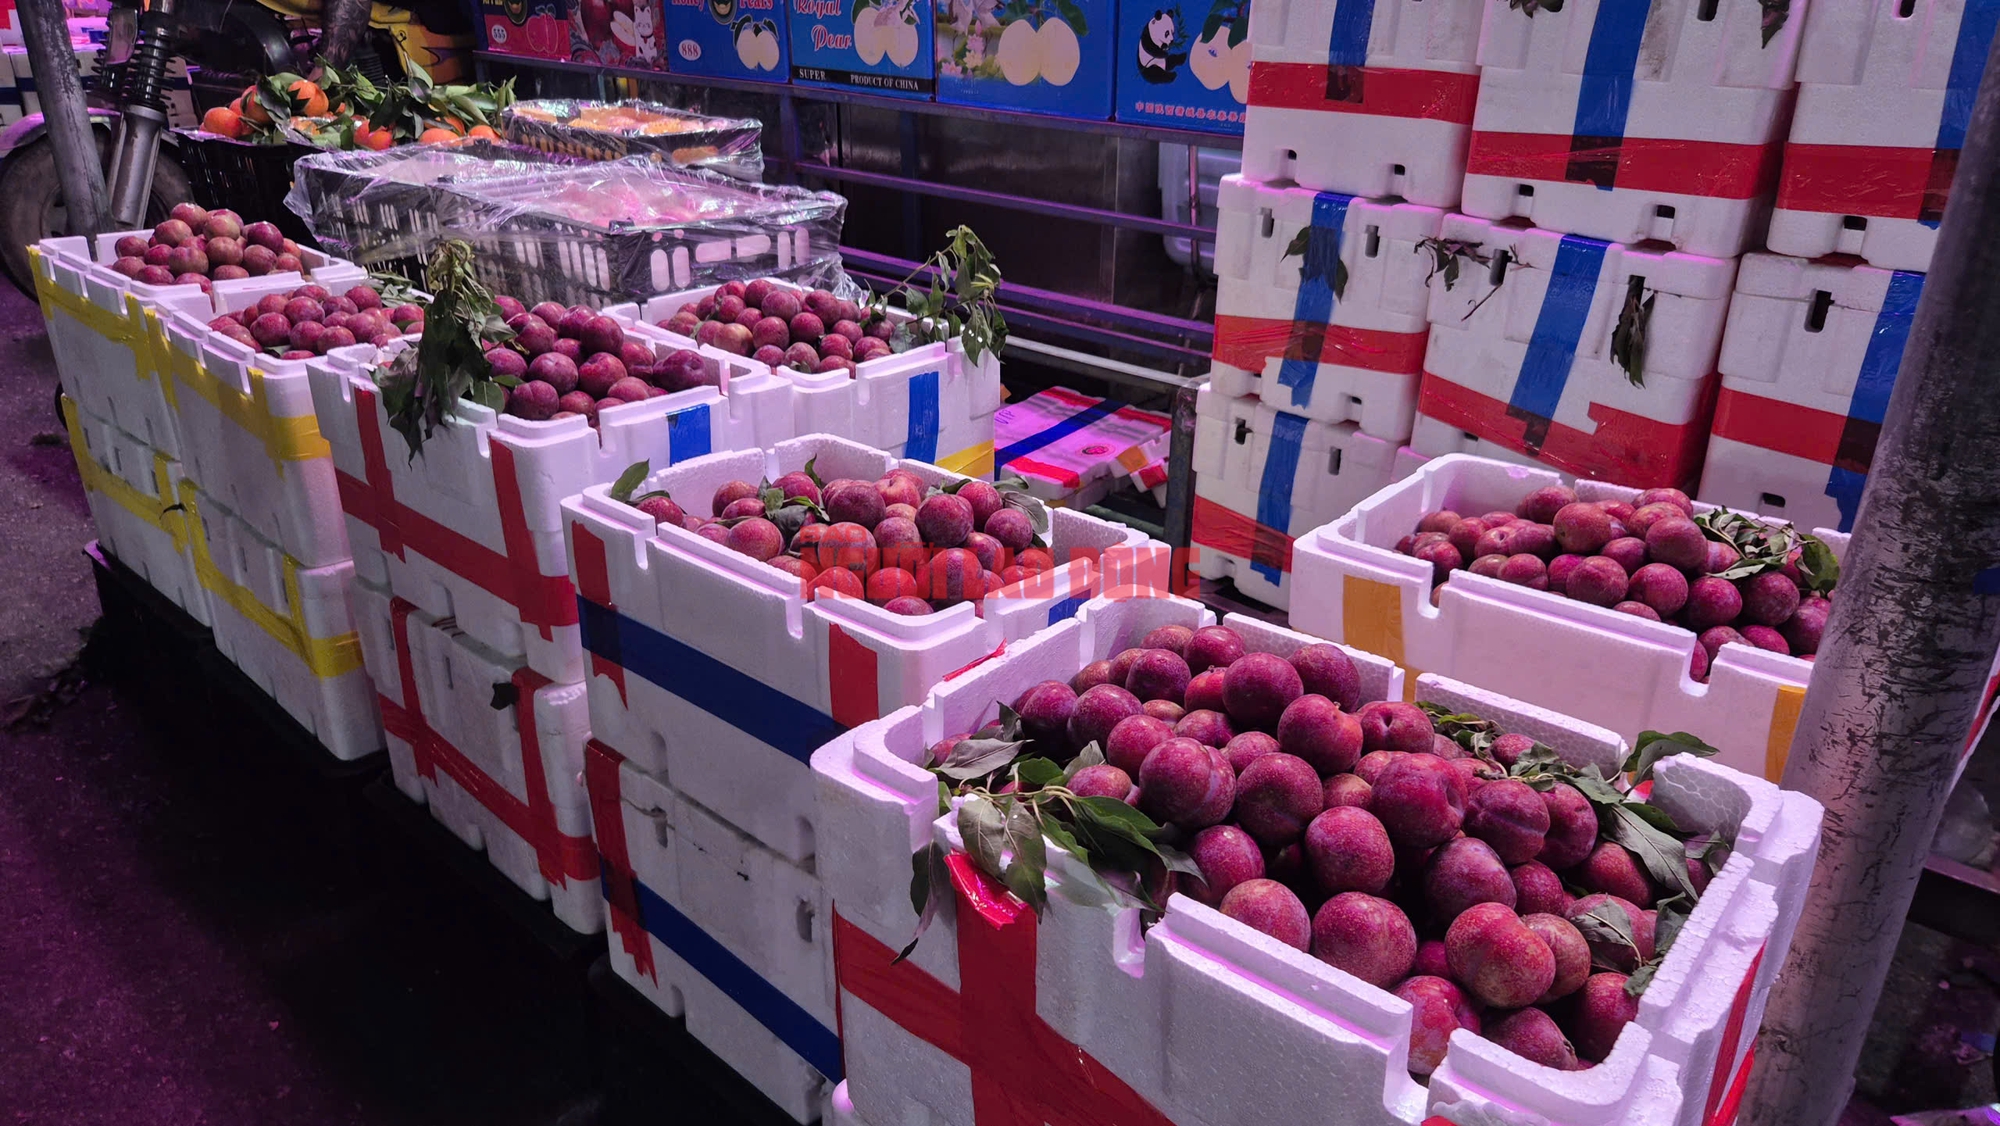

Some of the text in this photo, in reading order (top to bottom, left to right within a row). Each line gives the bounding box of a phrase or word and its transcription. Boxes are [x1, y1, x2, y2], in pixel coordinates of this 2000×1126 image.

[793, 0, 842, 19] Royal
[811, 24, 852, 51] Pear
[681, 43, 699, 57] 888
[799, 68, 919, 91] SUPER PRODUCT OF CHINA
